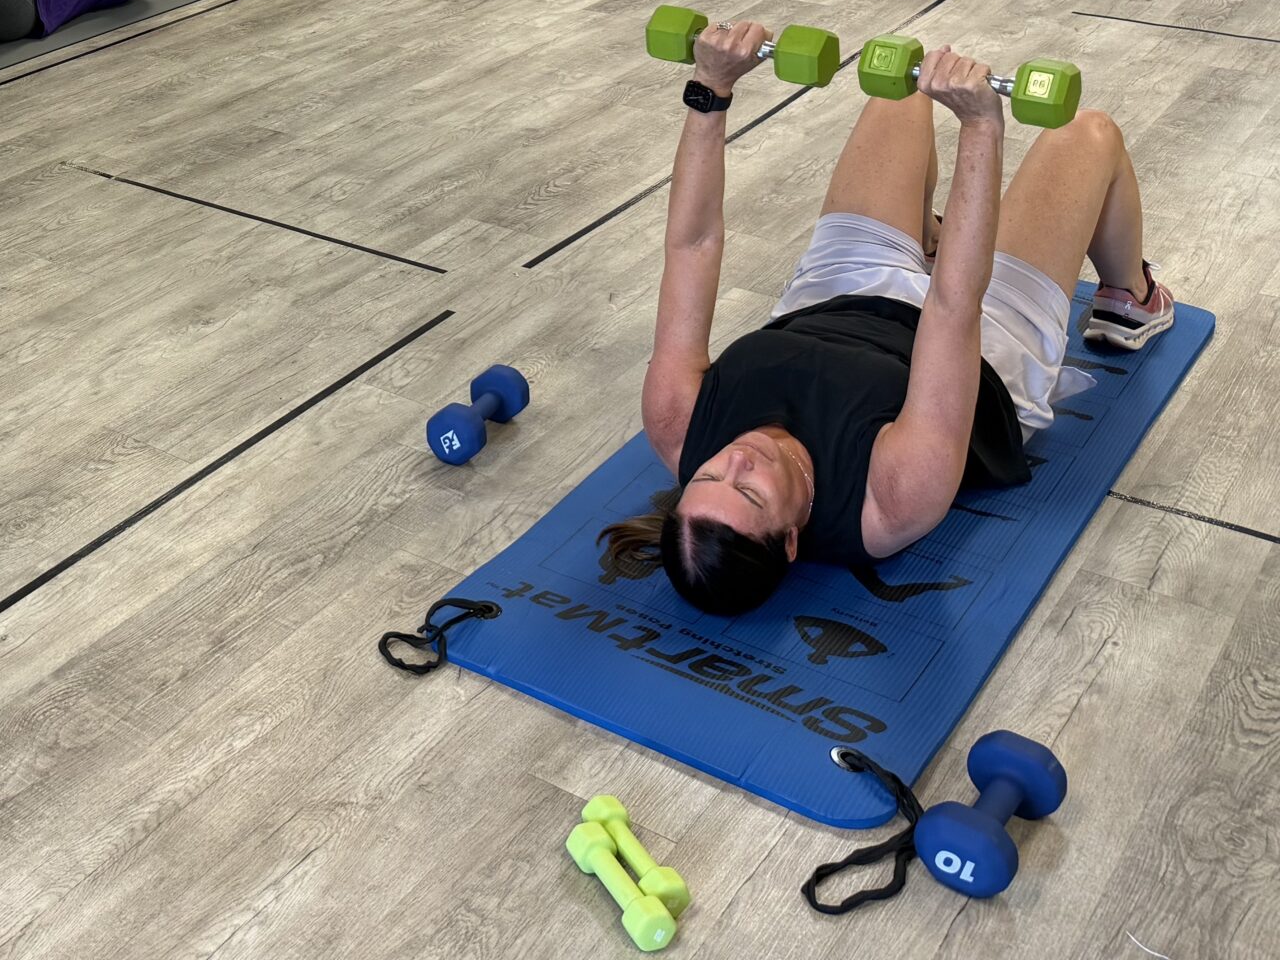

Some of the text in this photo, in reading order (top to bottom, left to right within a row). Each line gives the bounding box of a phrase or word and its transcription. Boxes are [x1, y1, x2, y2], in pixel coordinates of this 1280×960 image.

[501, 579, 888, 743] SmartMat
[678, 627, 788, 675] Stretching
[934, 849, 976, 883] 10
